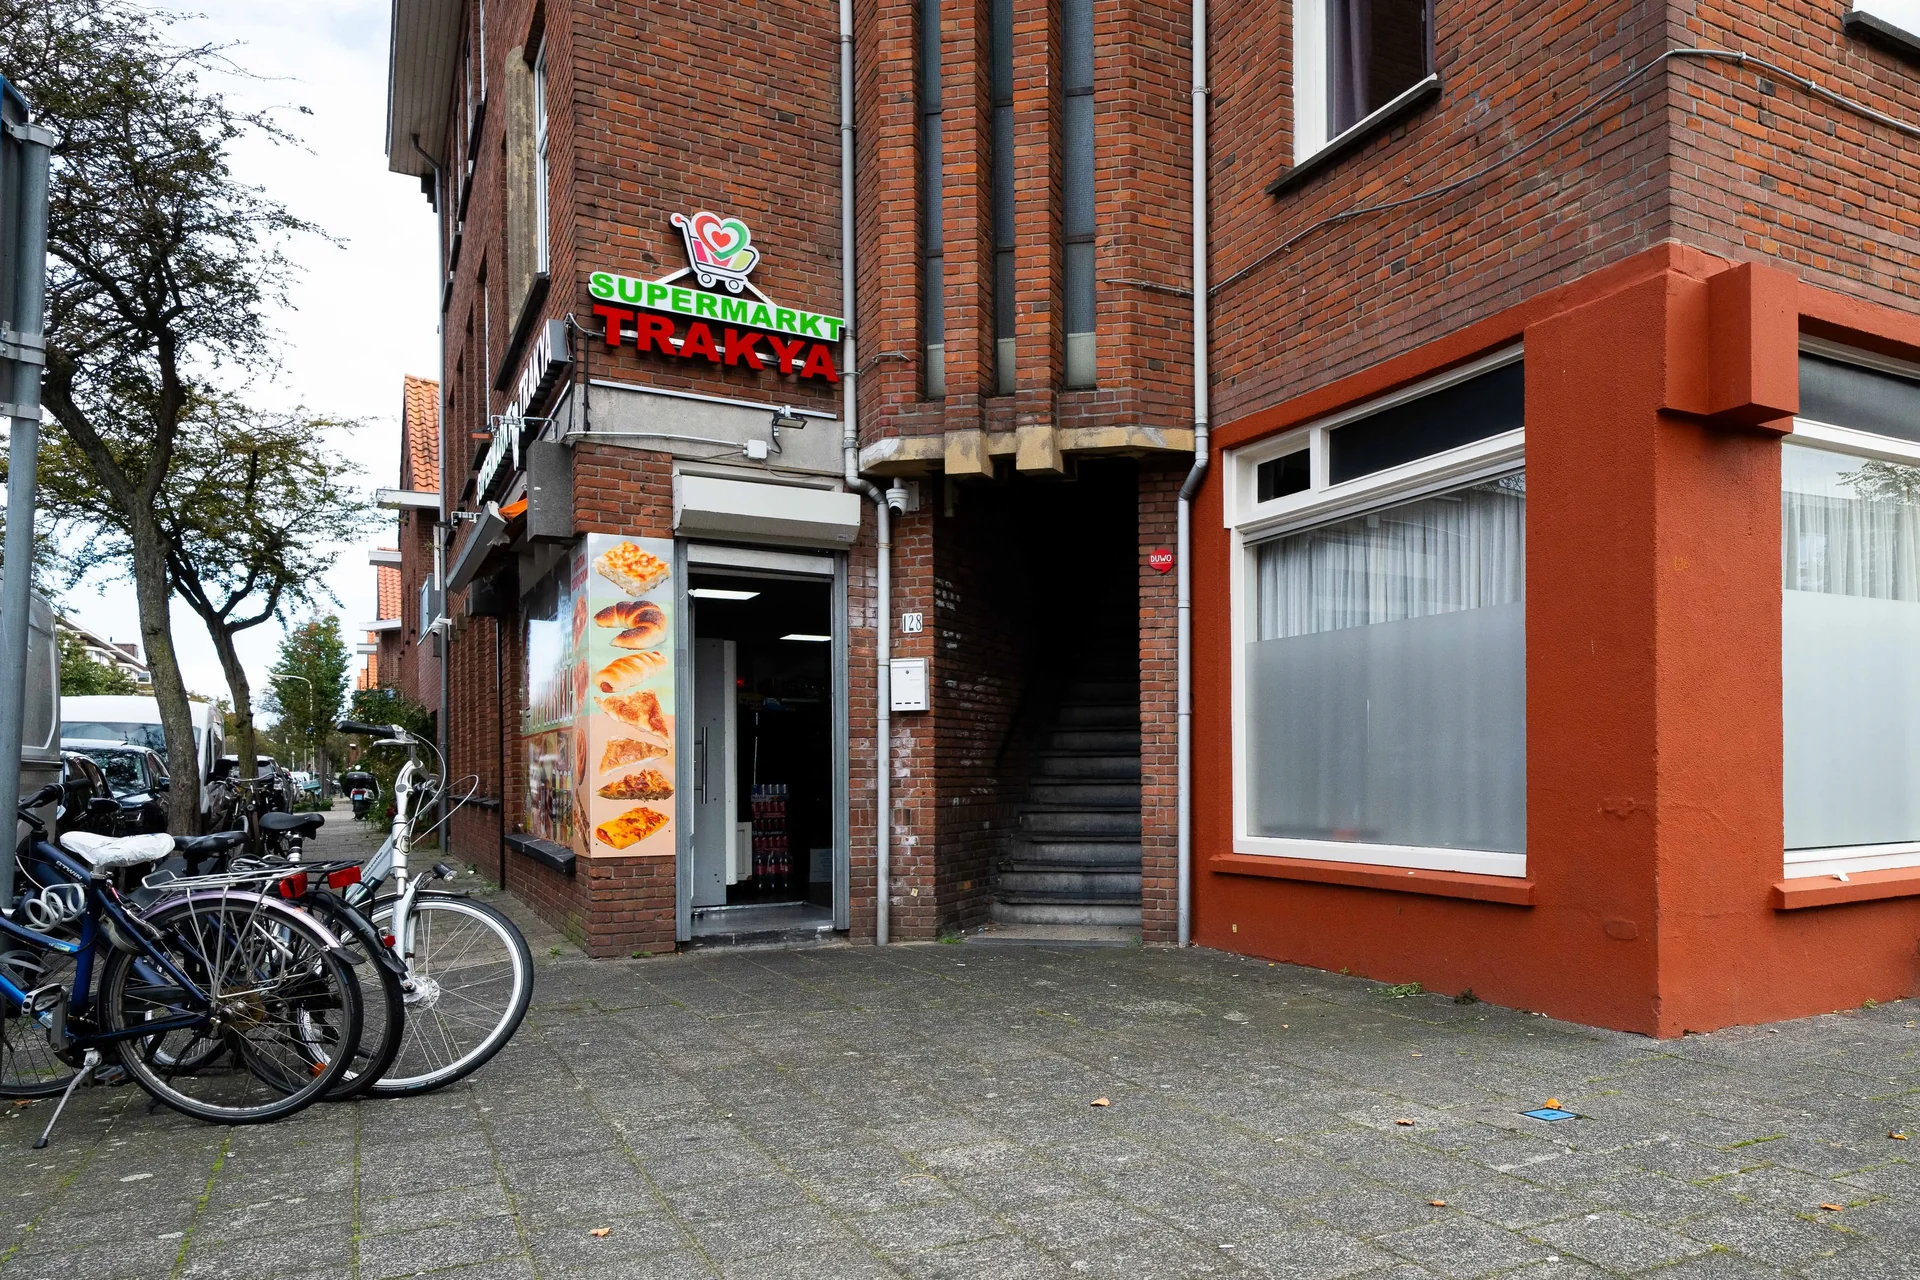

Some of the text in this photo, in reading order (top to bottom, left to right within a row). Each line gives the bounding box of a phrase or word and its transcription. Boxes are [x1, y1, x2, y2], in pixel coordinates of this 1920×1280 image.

[590, 272, 845, 341] SUPERMARKT
[518, 318, 552, 419] TRAKYA
[593, 304, 839, 383] TRAKYA
[1150, 554, 1172, 563] DUWO
[903, 614, 922, 632] 128
